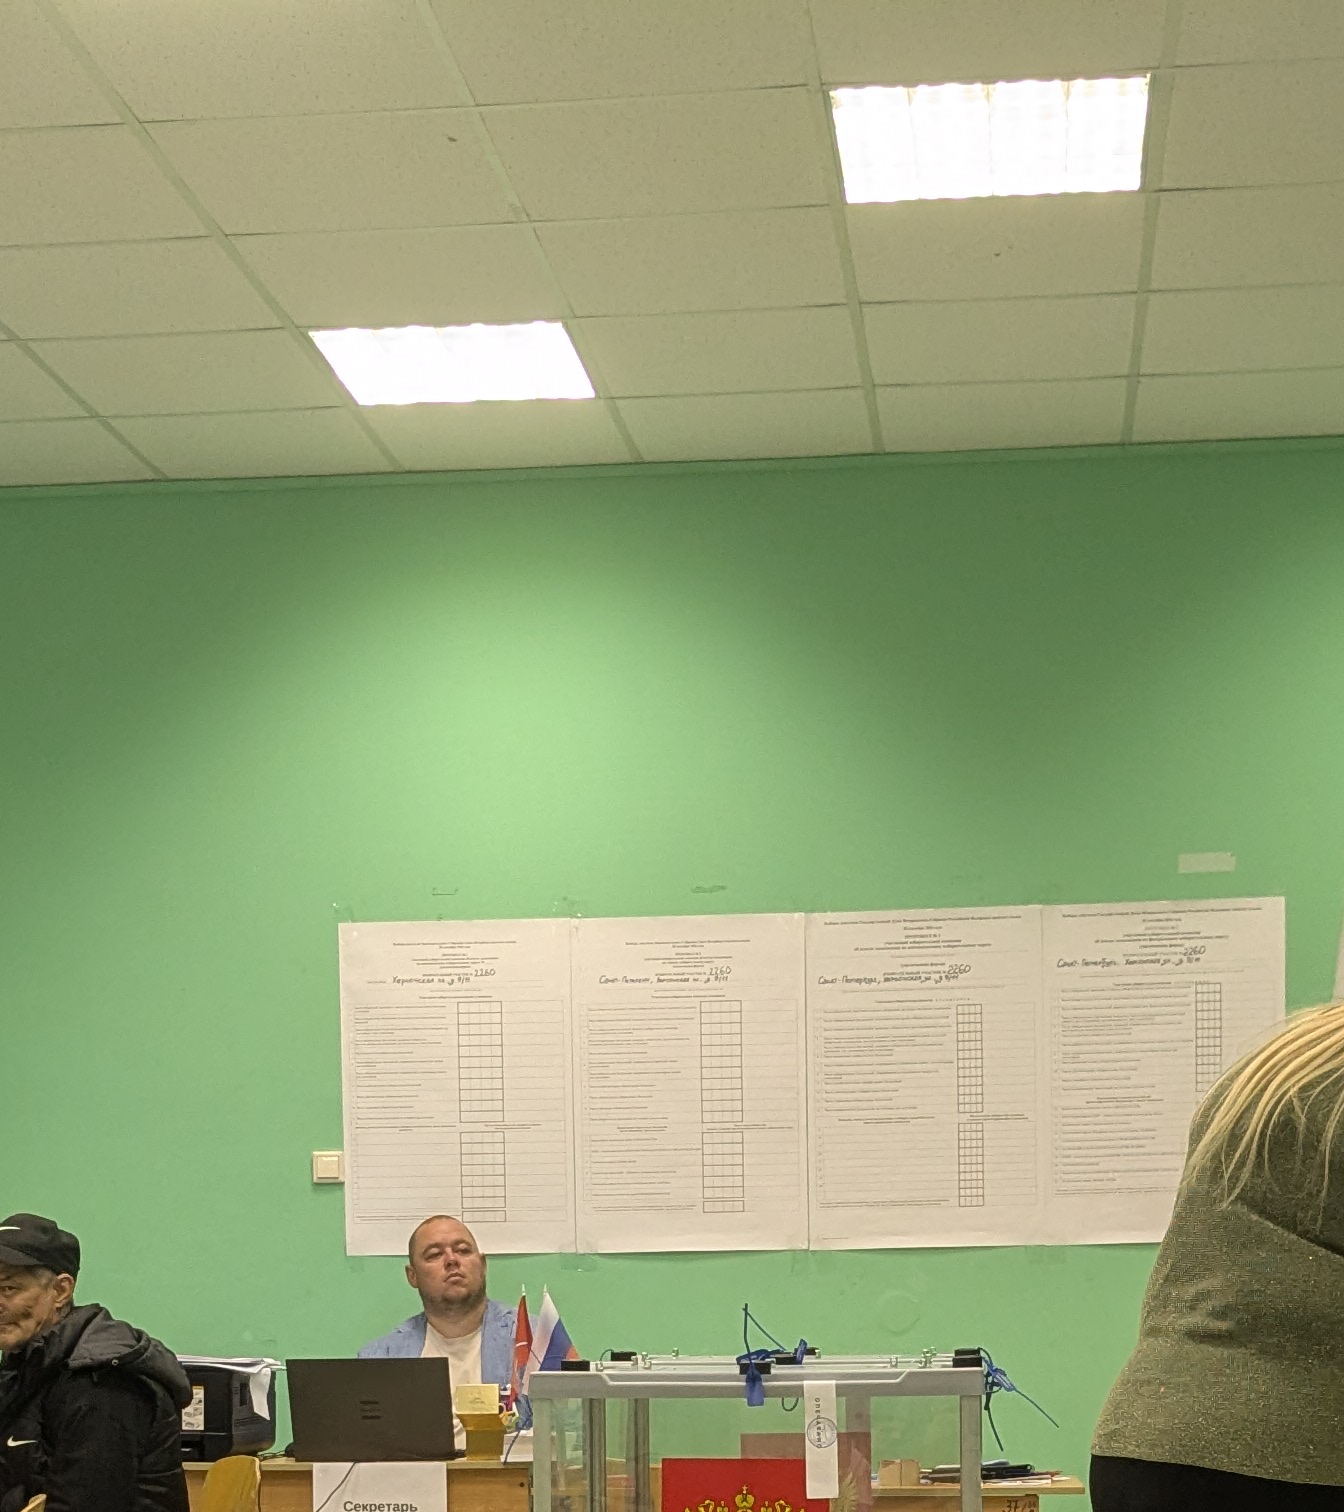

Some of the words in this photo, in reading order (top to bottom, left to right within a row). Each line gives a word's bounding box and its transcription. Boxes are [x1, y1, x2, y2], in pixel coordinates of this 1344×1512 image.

[474, 968, 497, 977] 2260
[709, 965, 732, 976] 2260
[947, 964, 972, 976] 2260
